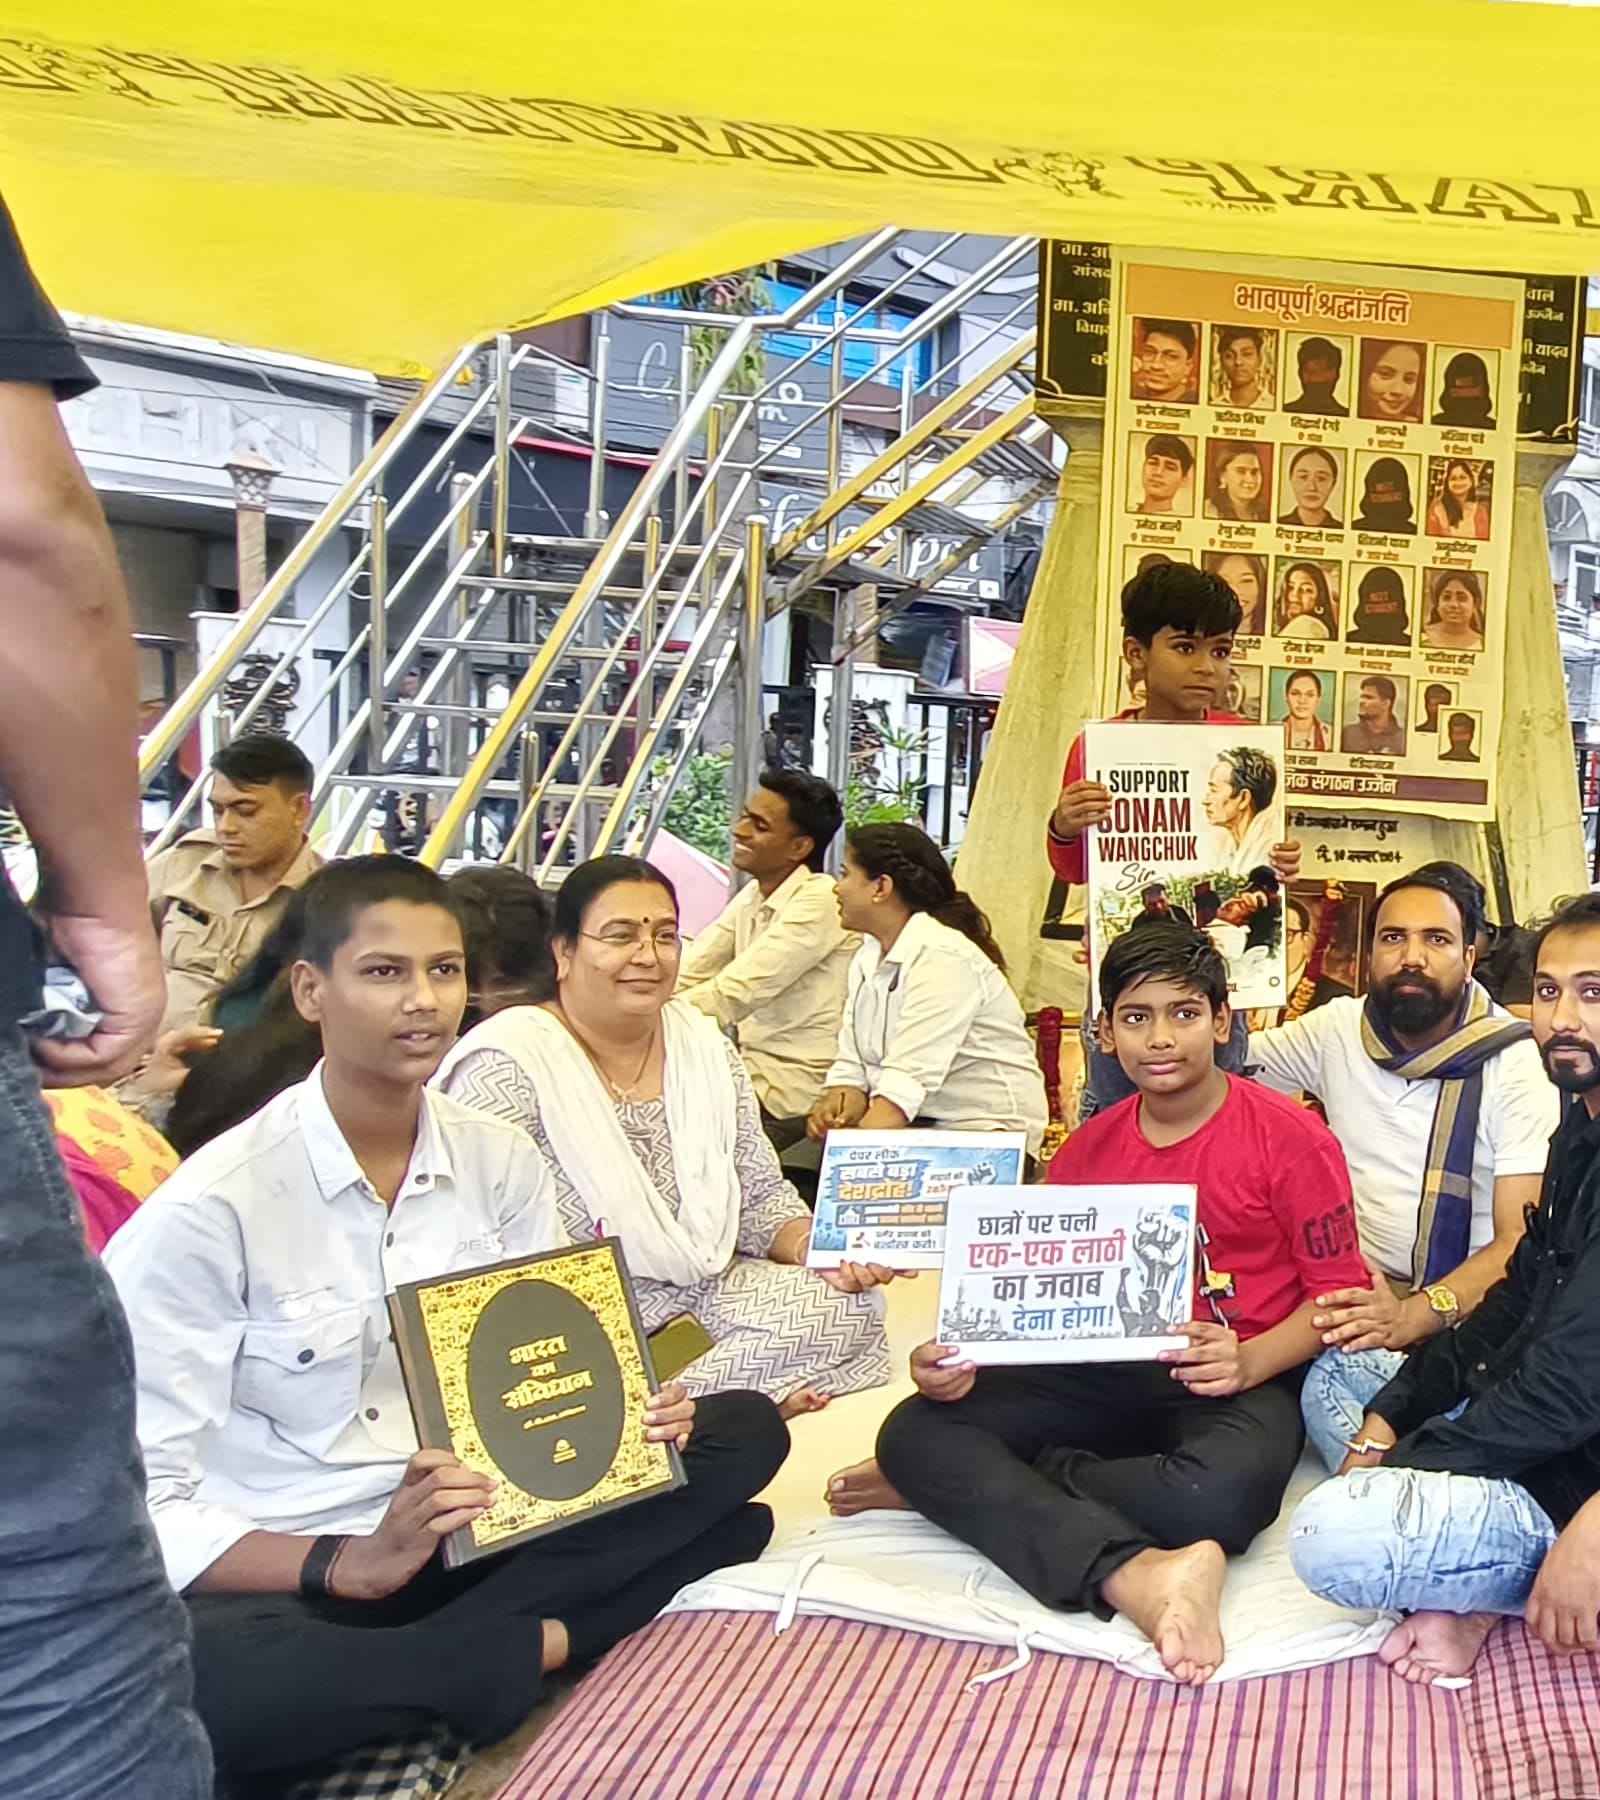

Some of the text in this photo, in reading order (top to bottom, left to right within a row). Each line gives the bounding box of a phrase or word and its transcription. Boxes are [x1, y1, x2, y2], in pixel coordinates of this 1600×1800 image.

[1235, 283, 1411, 326] भावपूर्ण श्रद्धांजलि
[1109, 770, 1190, 794] SUPPORT
[1311, 771, 1354, 791] संगठन
[1357, 773, 1398, 794] उज्जैन
[1097, 836, 1198, 863] WANGCHUK
[1115, 863, 1166, 893] Sir
[978, 1207, 1098, 1235] छात्रों पर चली
[968, 1228, 1127, 1269] एक-एक लाठी
[992, 1270, 1104, 1301] का जवाब
[1012, 1300, 1114, 1332] देना होगा!
[509, 1335, 568, 1365] भारत
[501, 1370, 593, 1409] संविधान
